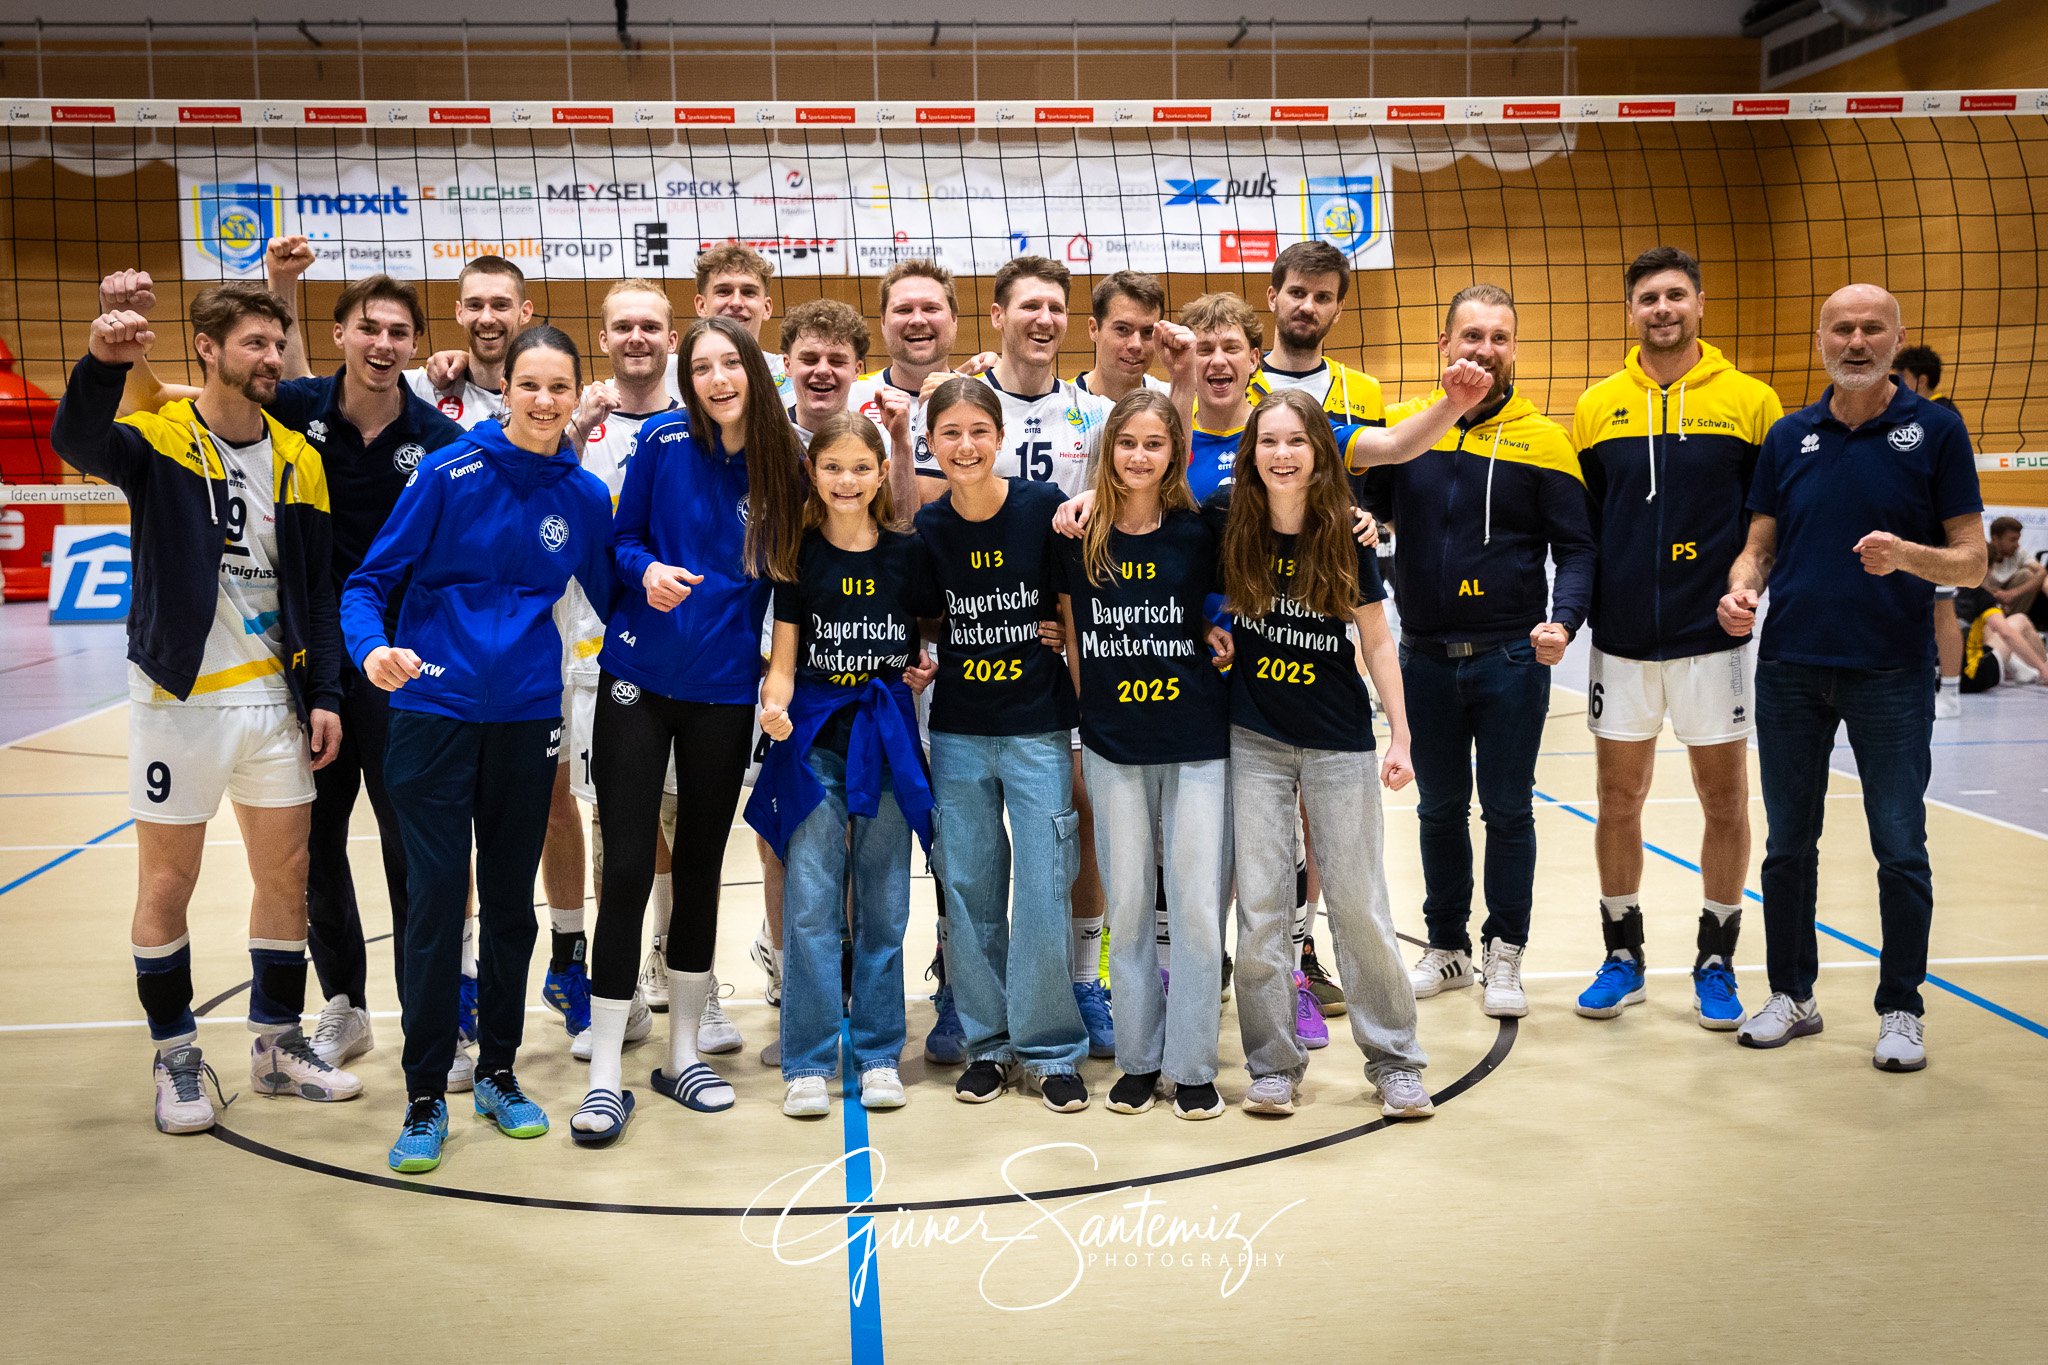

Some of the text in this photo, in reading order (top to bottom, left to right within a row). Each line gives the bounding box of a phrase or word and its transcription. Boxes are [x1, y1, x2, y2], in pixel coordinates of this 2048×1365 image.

[269, 113, 283, 121] Zapf
[1001, 113, 1014, 121] Zapf
[1237, 112, 1250, 120] Zapf
[448, 186, 532, 200] FUCHS
[547, 184, 652, 200] MEYSEL
[667, 182, 720, 196] SPECK
[1226, 172, 1276, 204] puls
[297, 186, 409, 214] maxit
[350, 248, 412, 262] Daigfuss
[1682, 418, 1735, 431] SV Schwaig
[659, 431, 689, 444] Kempa
[1478, 434, 1491, 442] SV
[450, 460, 483, 480] Kempa
[1016, 441, 1053, 482] 15
[1218, 462, 1236, 471] err
[11, 490, 115, 502] Ideen umsetzen
[227, 496, 247, 542] 9
[971, 550, 1004, 569] U13
[1672, 542, 1697, 561] PS
[1122, 561, 1156, 580] U13
[843, 577, 875, 595] U13
[1458, 580, 1484, 596] AL
[946, 582, 1039, 620] Bayerische
[1092, 596, 1184, 631] Bayerisch
[619, 630, 637, 647] AA
[812, 613, 906, 646] Bayerische
[949, 619, 1041, 645] eisterinne
[1082, 631, 1196, 659] Meisterinnen
[419, 661, 445, 678] KW
[963, 659, 1022, 682] 2025
[1256, 656, 1316, 685] 2025
[1117, 677, 1180, 703] 2025
[546, 746, 560, 758] Kem
[147, 761, 171, 803] 9
